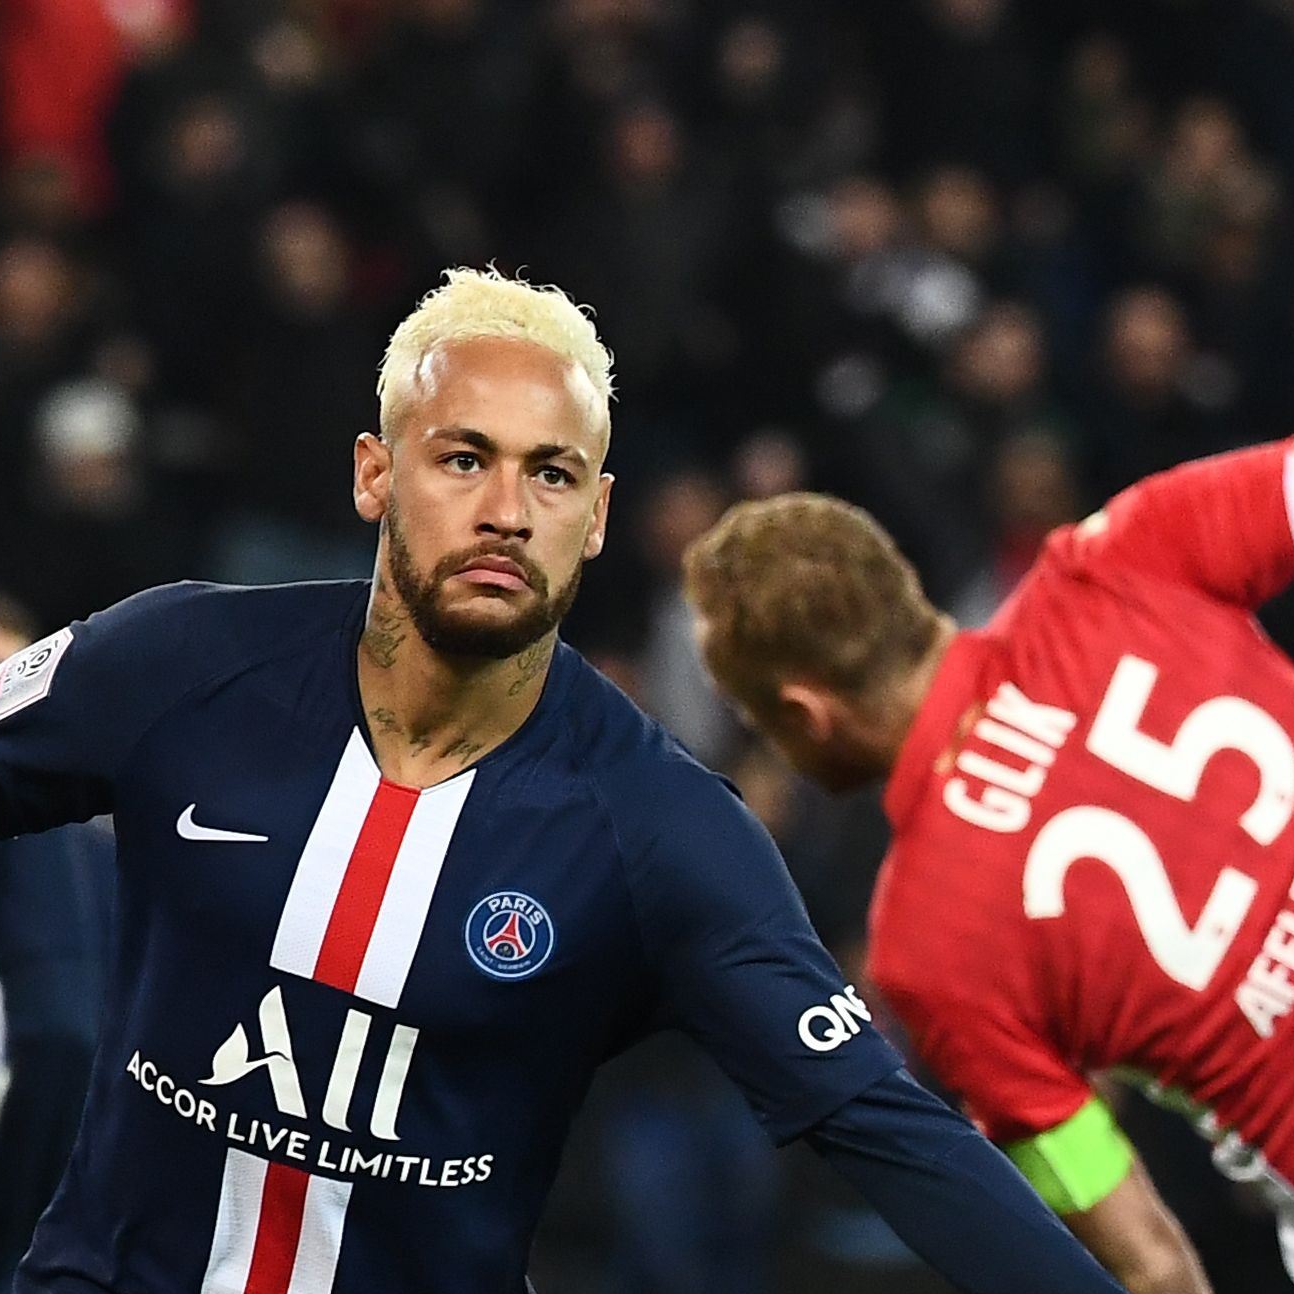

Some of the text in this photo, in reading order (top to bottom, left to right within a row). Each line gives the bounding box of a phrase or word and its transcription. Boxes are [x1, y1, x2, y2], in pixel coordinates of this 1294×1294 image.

[942, 680, 1078, 834] GLIK
[487, 896, 544, 926] PARIS
[126, 1049, 494, 1187] ACCOR LIVE LIMITLESS
